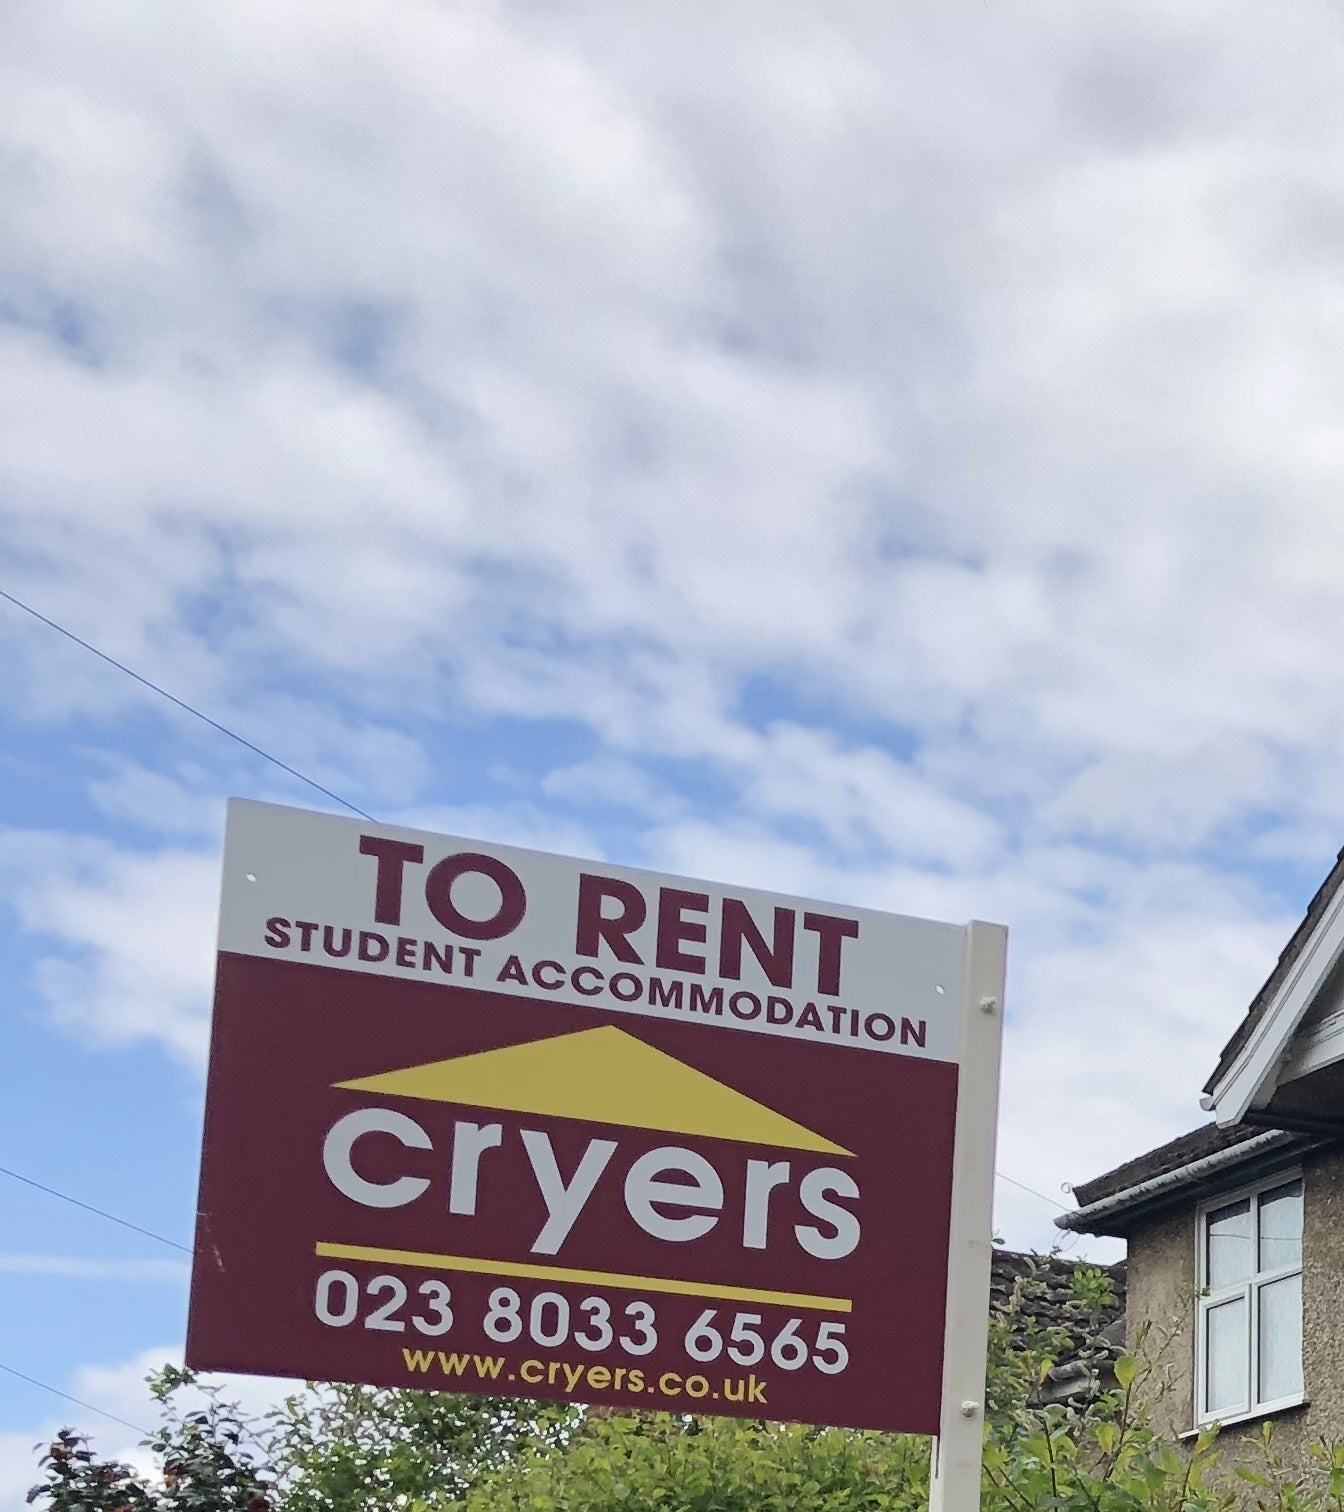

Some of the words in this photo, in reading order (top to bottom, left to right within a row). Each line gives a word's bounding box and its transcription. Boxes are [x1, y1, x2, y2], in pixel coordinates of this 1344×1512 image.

[359, 835, 527, 941] TO
[576, 873, 860, 998] RENT
[264, 917, 482, 978] STUDENT
[496, 955, 927, 1049] ACCOMMODATION
[322, 1107, 861, 1260] cryers
[315, 1269, 454, 1336] 023
[483, 1287, 658, 1356] 8033
[684, 1309, 849, 1375] 6565
[401, 1348, 768, 1404] www.cryers.co.uk
